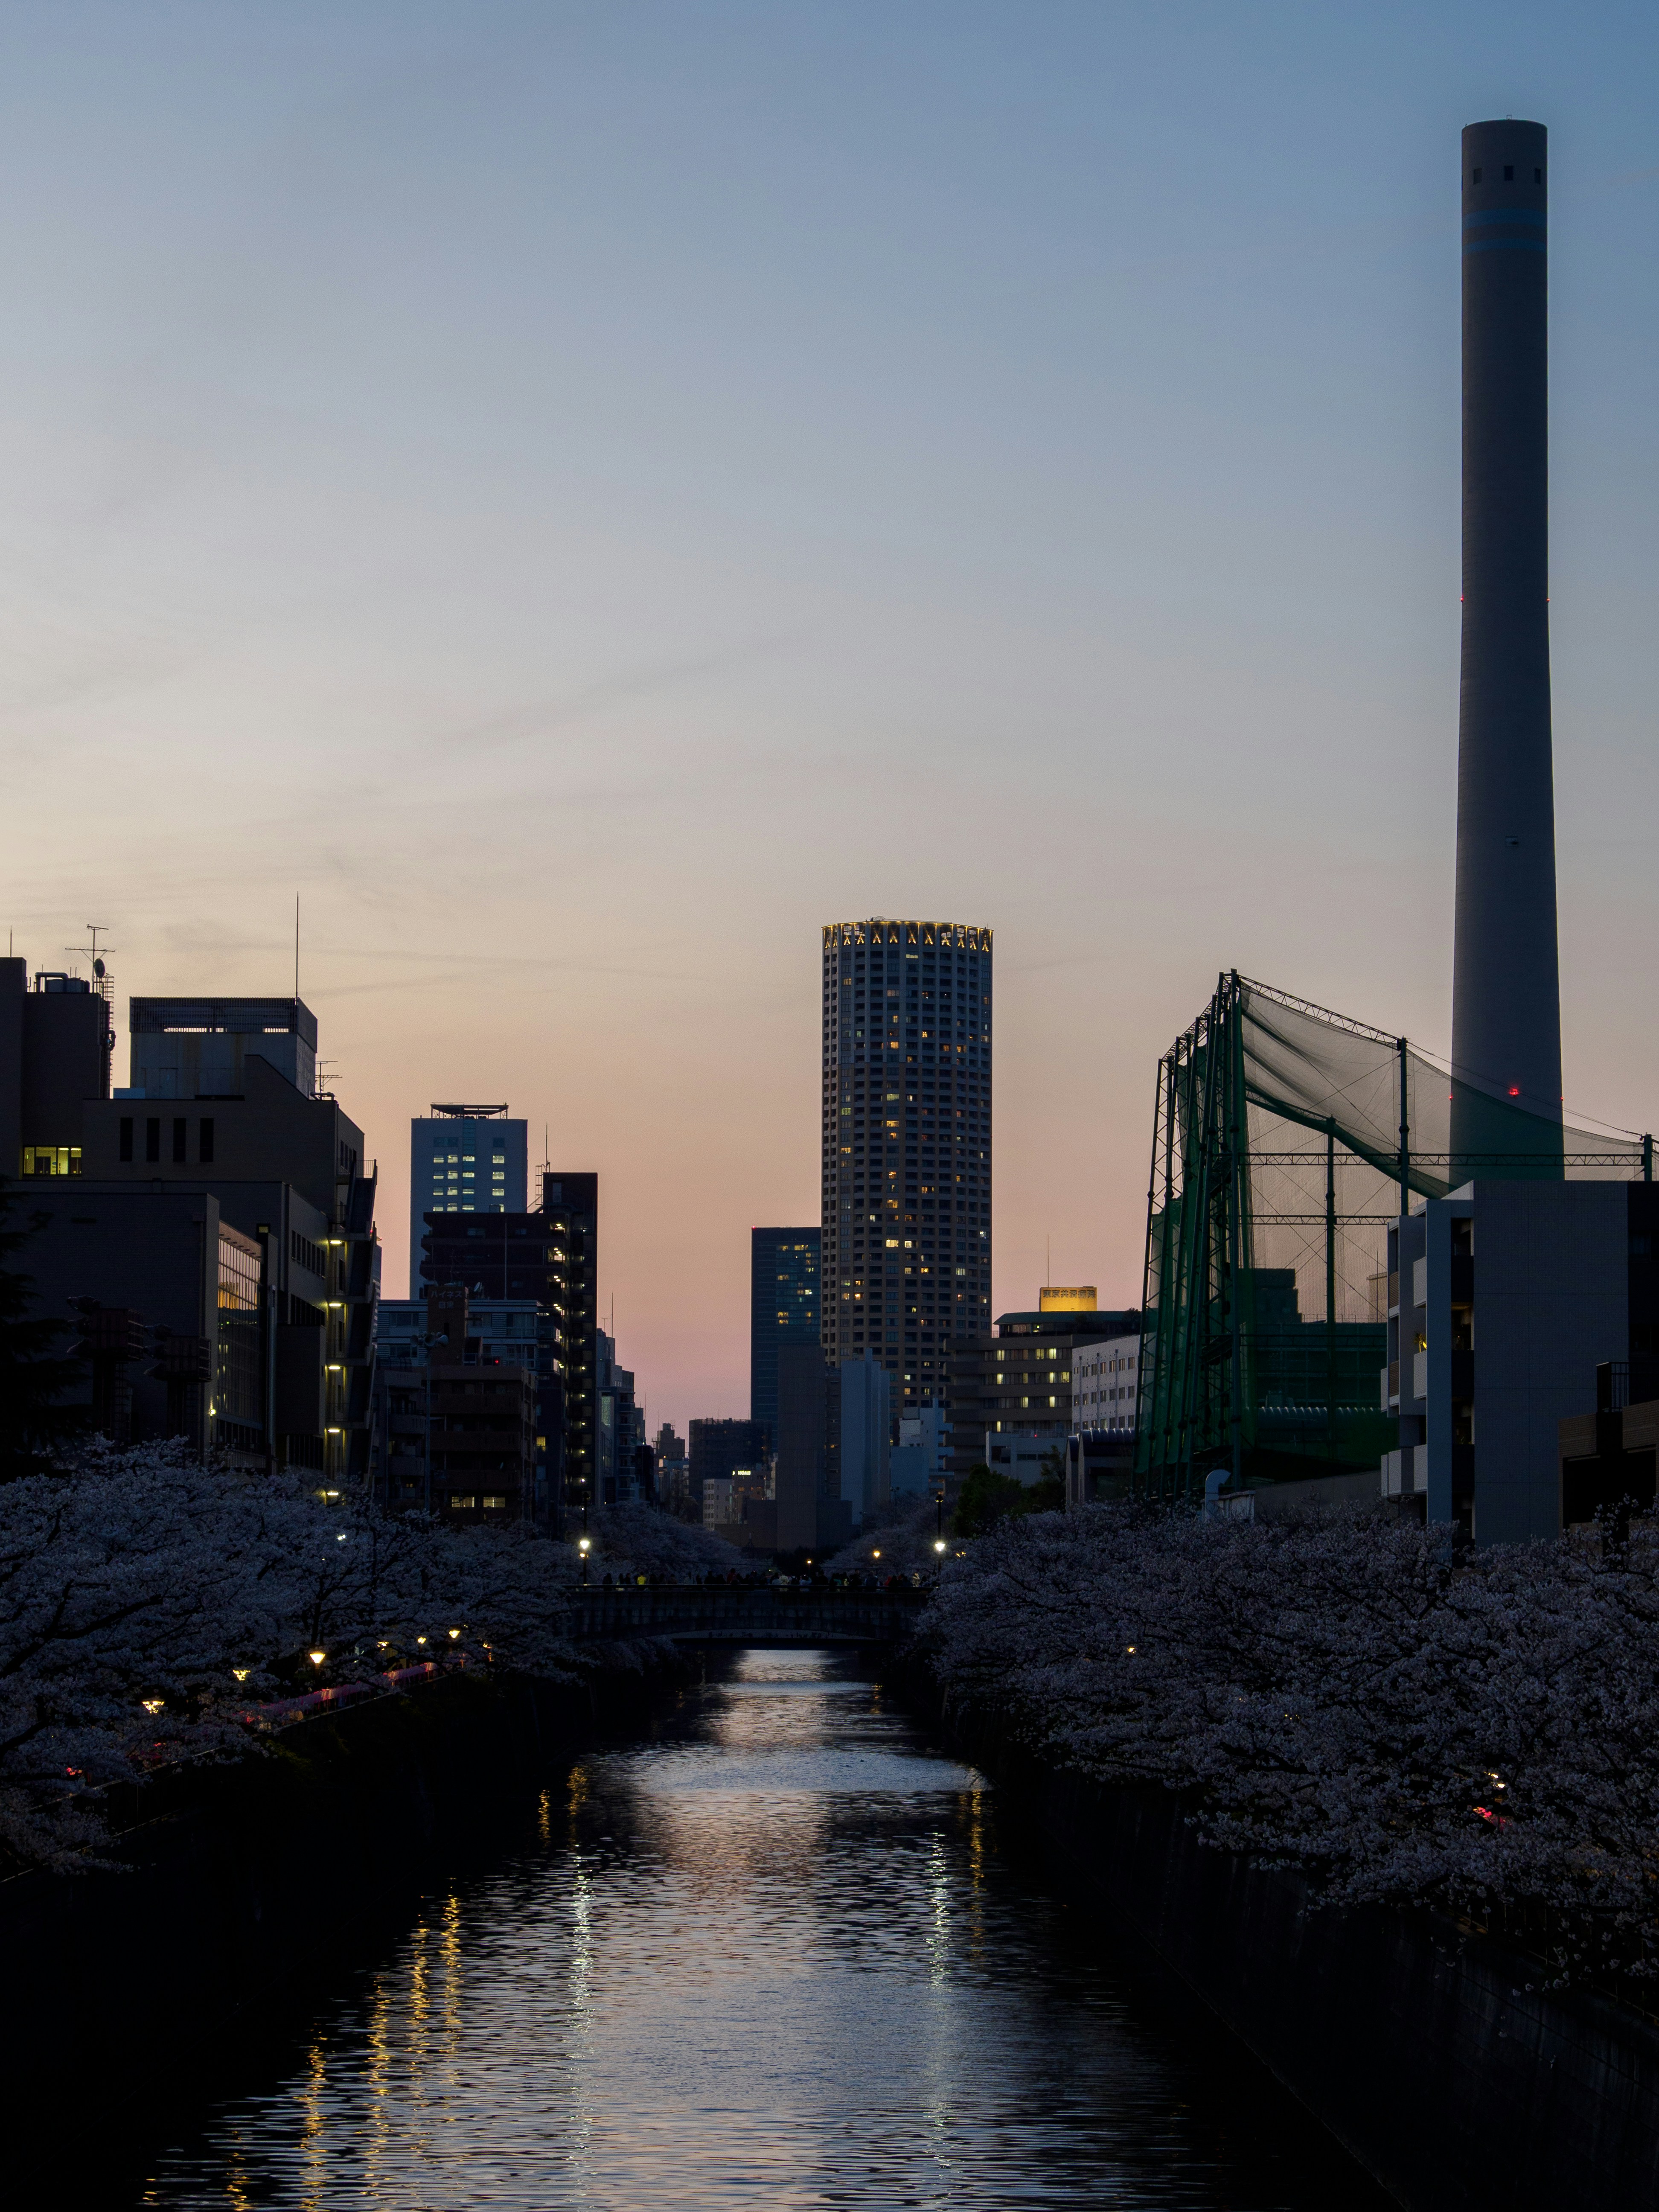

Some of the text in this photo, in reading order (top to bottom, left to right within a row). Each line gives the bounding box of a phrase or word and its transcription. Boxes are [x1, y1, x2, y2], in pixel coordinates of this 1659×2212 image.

[431, 1290, 463, 1298] ハイネス
[1043, 1289, 1095, 1298] 東京共済病院
